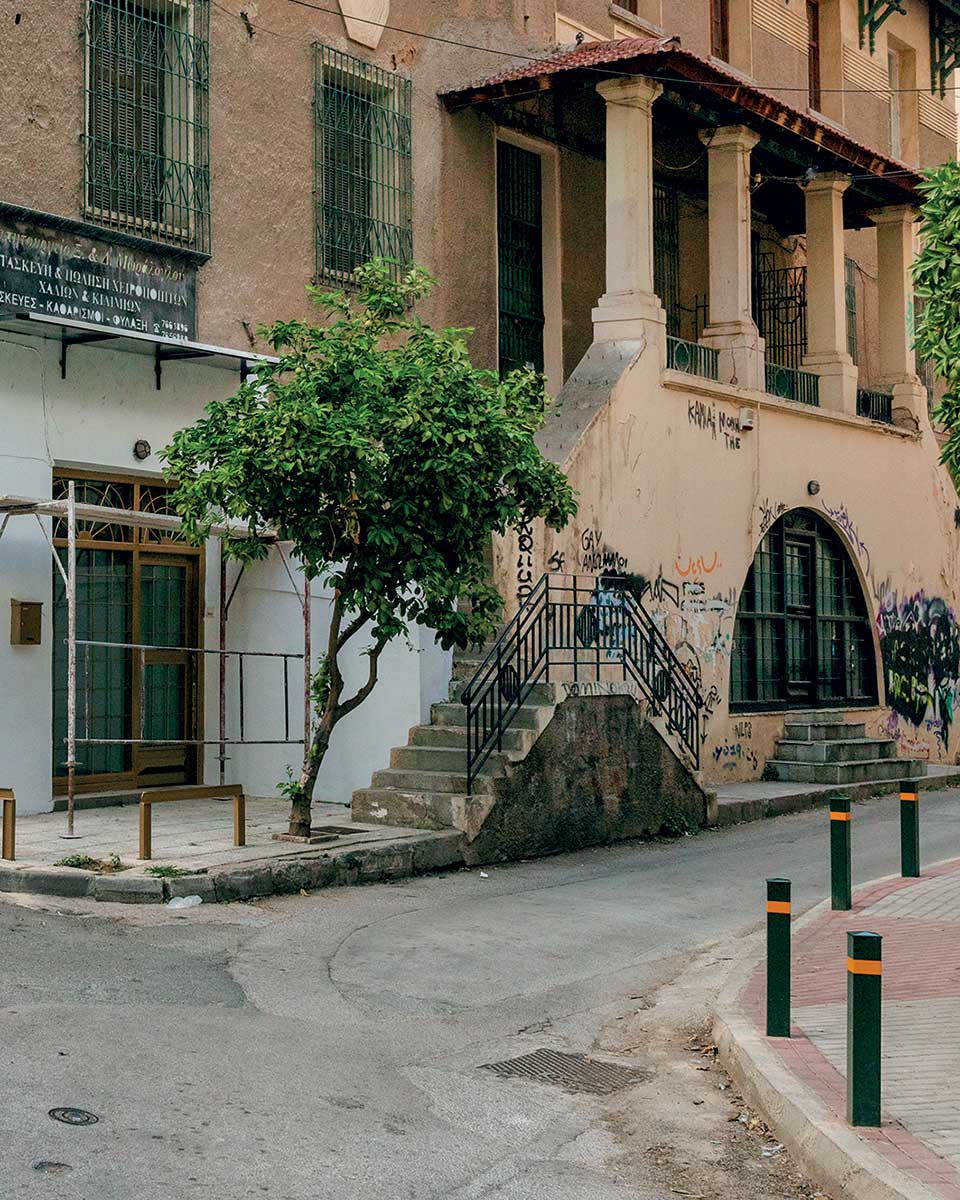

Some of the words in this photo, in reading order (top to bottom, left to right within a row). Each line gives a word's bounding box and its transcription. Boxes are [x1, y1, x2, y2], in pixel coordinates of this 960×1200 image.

[88, 247, 97, 262] &
[54, 267, 62, 280] &
[81, 290, 89, 303] &
[46, 301, 104, 323] ΚΑΘΑΡΙΣΜΟΙ
[112, 315, 148, 332] ΦΥΛΑΞΗ
